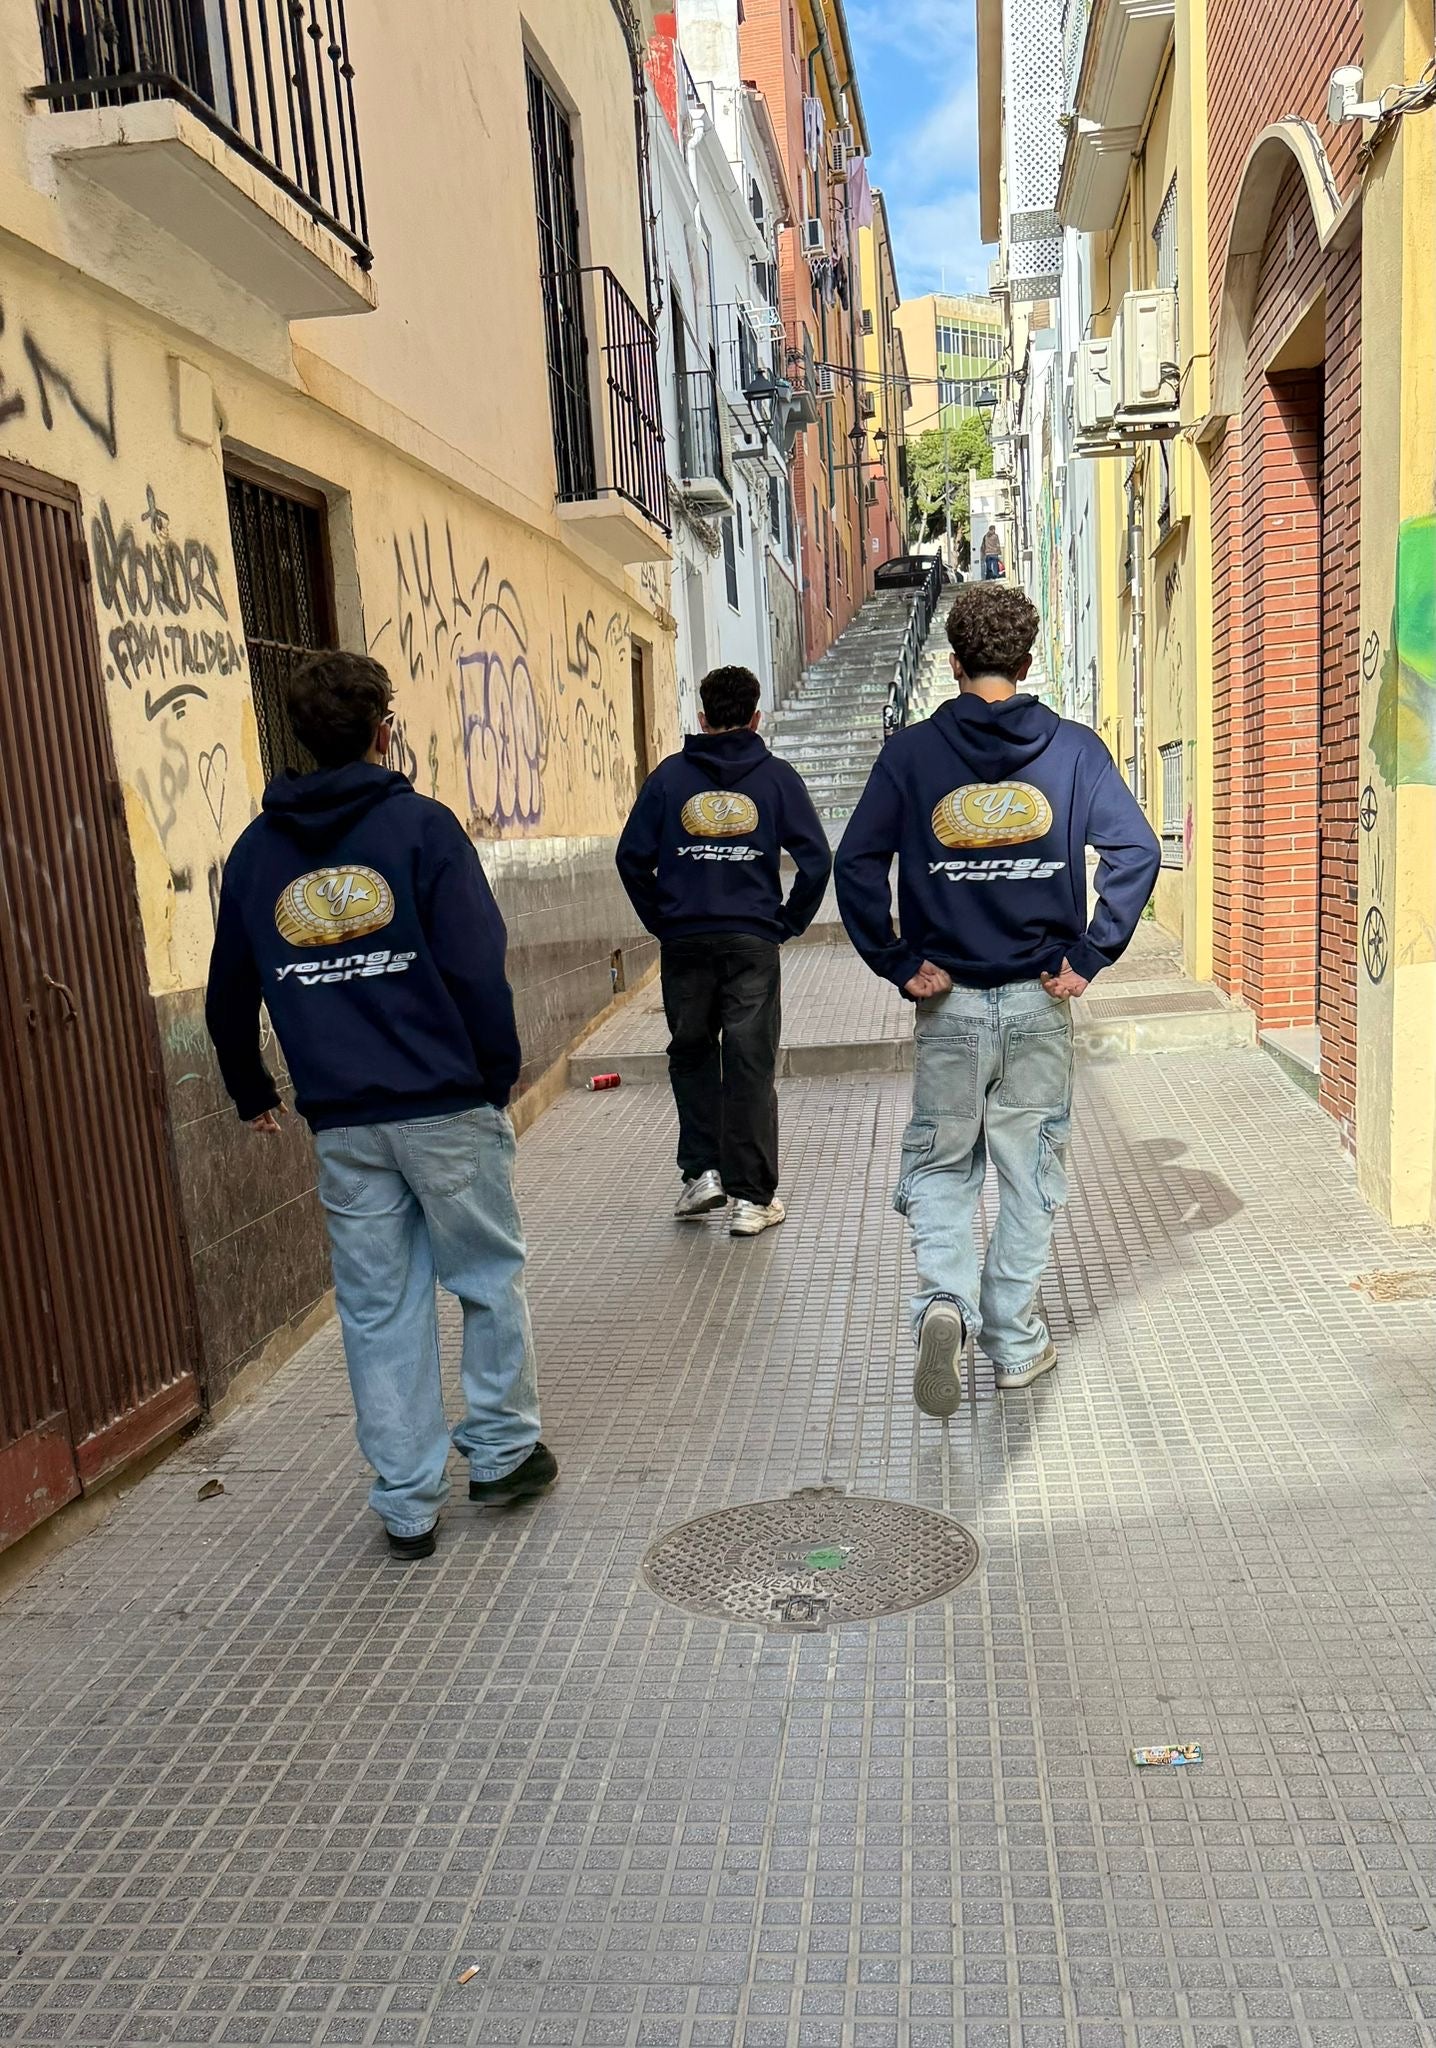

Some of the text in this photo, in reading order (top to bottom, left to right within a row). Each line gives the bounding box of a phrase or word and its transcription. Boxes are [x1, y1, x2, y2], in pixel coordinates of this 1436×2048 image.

[928, 858, 1041, 874] young
[946, 869, 1055, 881] verse
[275, 950, 392, 981] young
[297, 961, 409, 985] verse
